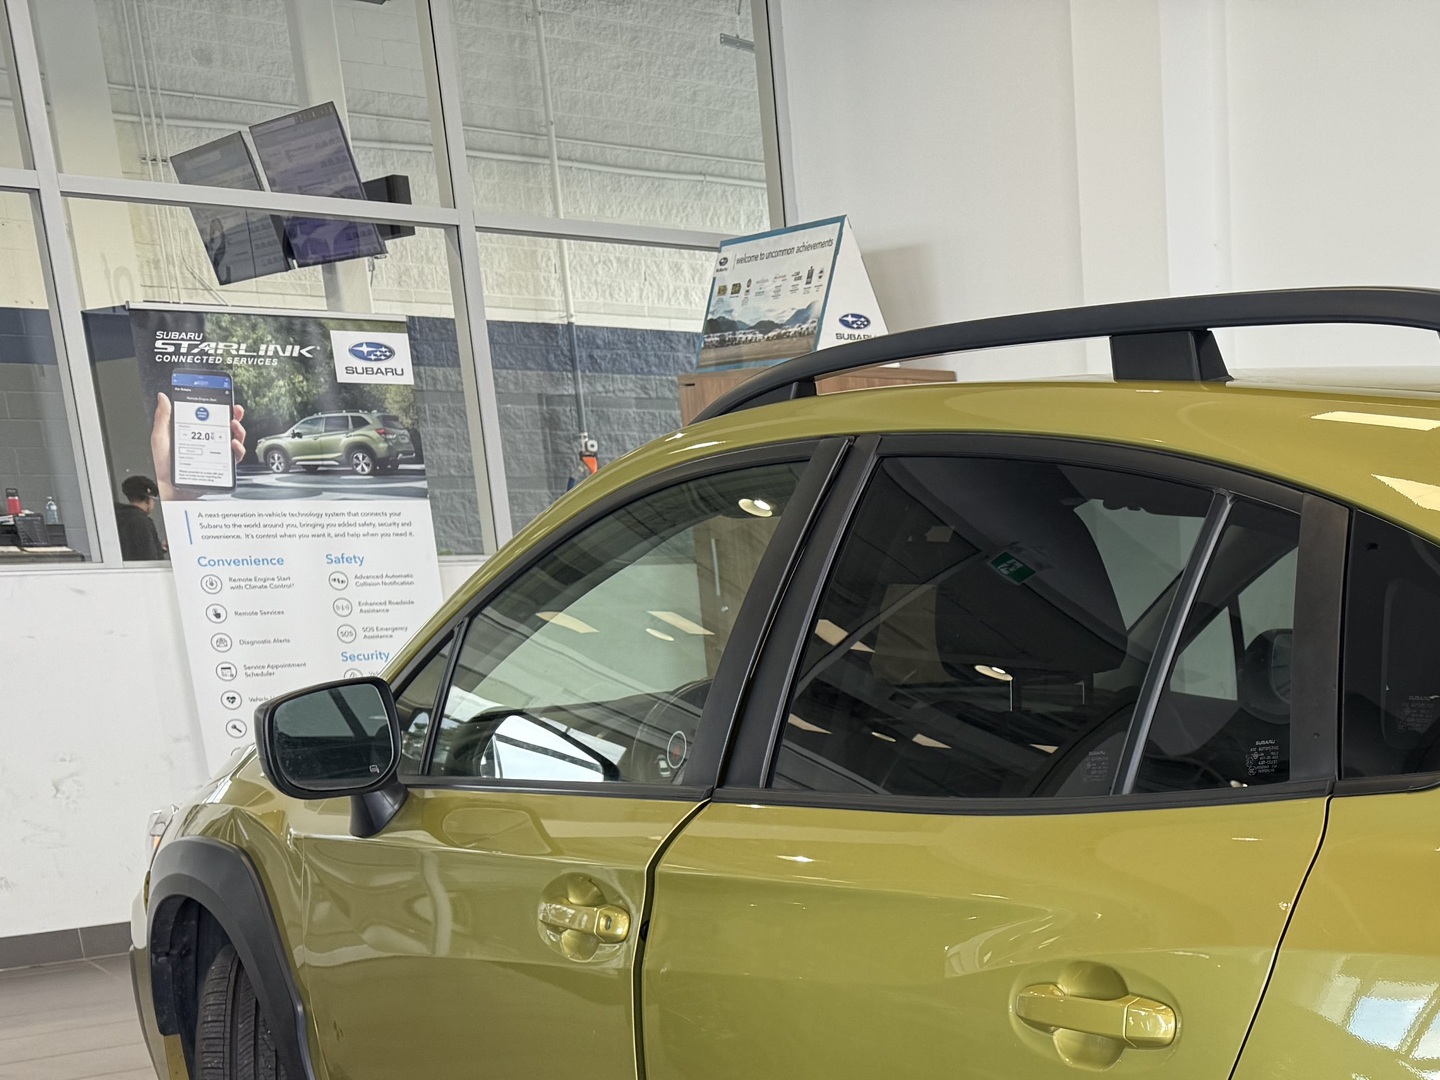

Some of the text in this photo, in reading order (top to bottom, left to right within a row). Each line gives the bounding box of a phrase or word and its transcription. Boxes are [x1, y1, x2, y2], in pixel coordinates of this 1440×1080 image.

[736, 238, 834, 265] welcome to uncommon achievements
[156, 331, 203, 340] SUBARU
[835, 332, 877, 341] SUBAR
[154, 340, 316, 358] STARLINK
[155, 354, 278, 366] CONNECTED SERVICES
[344, 366, 404, 376] SUBARU
[205, 512, 256, 520] next-generation
[289, 511, 323, 519] technology
[197, 555, 285, 567] Convenience
[325, 552, 365, 567] Safety
[340, 650, 390, 662] Security
[266, 662, 307, 670] Appointment
